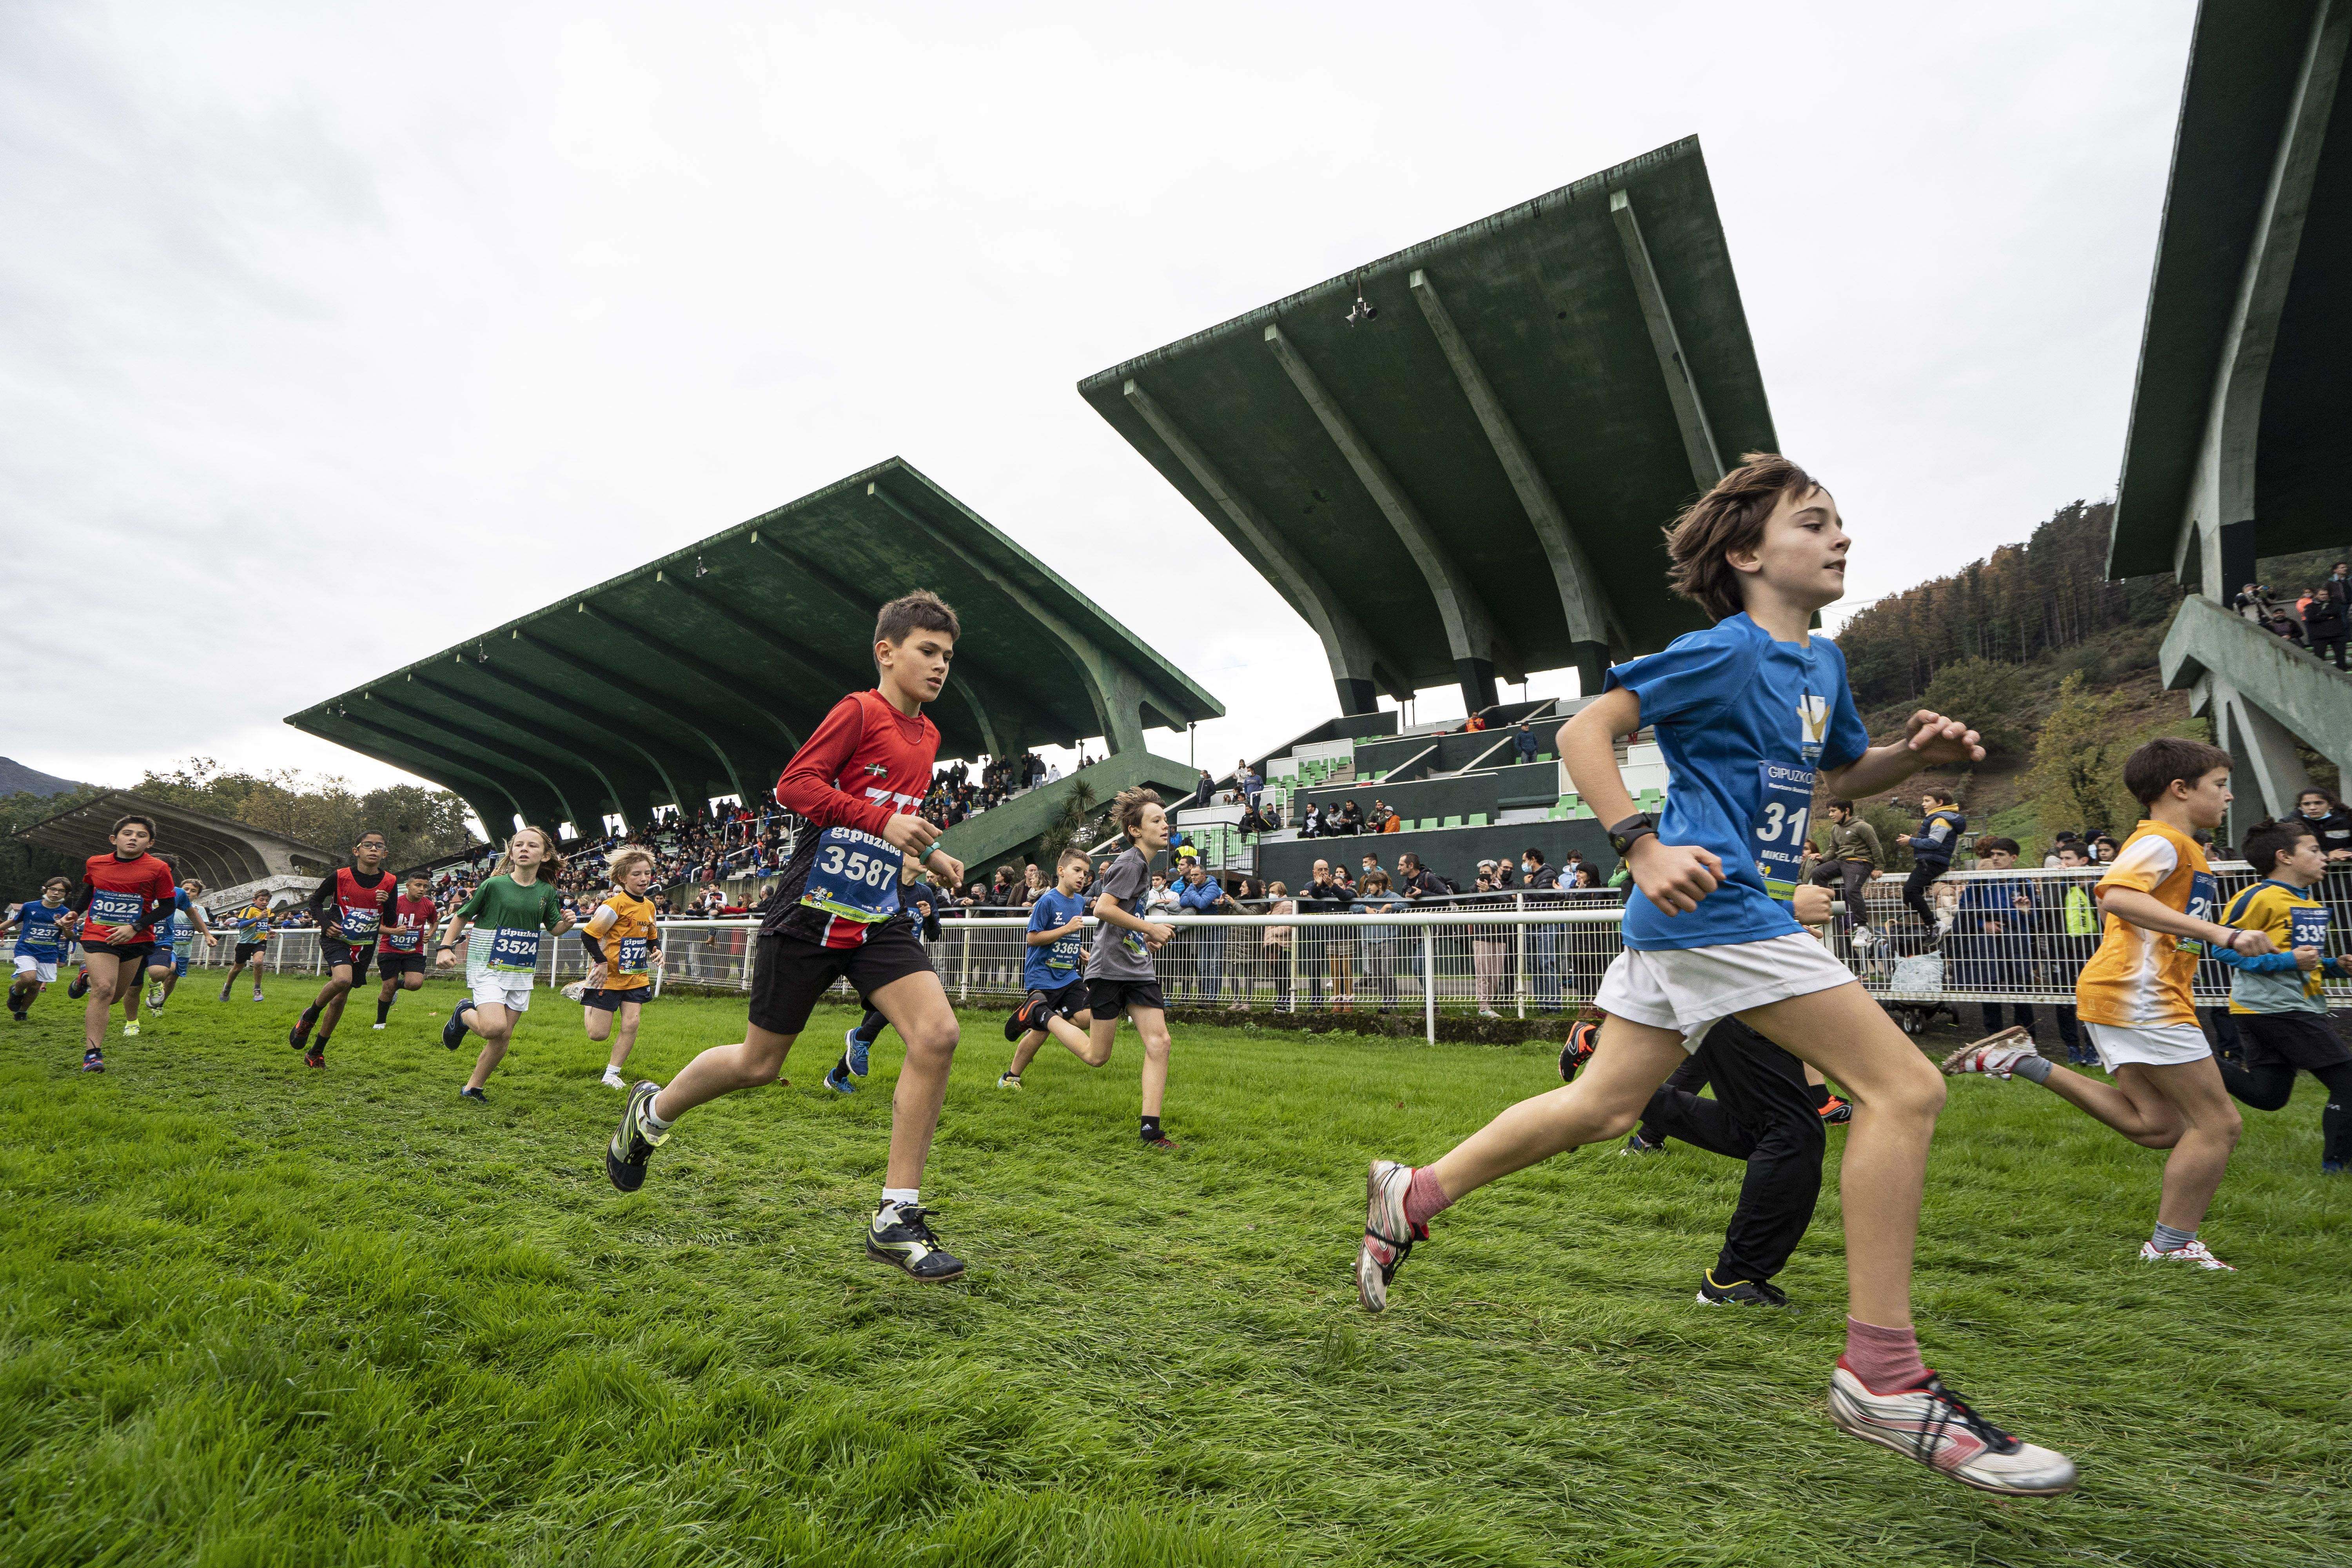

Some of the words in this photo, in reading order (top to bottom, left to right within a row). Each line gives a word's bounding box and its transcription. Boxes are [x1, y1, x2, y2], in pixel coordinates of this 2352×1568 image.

[830, 827, 901, 857] gipuzkoa
[1761, 849, 1791, 862] MIKEL
[820, 846, 897, 891] 3587
[93, 899, 140, 914] 3022
[29, 927, 59, 936] 3237
[500, 928, 539, 938] gipuzkoa
[392, 935, 418, 944] 3019
[496, 938, 537, 955] 3524
[1052, 942, 1080, 955] 3365
